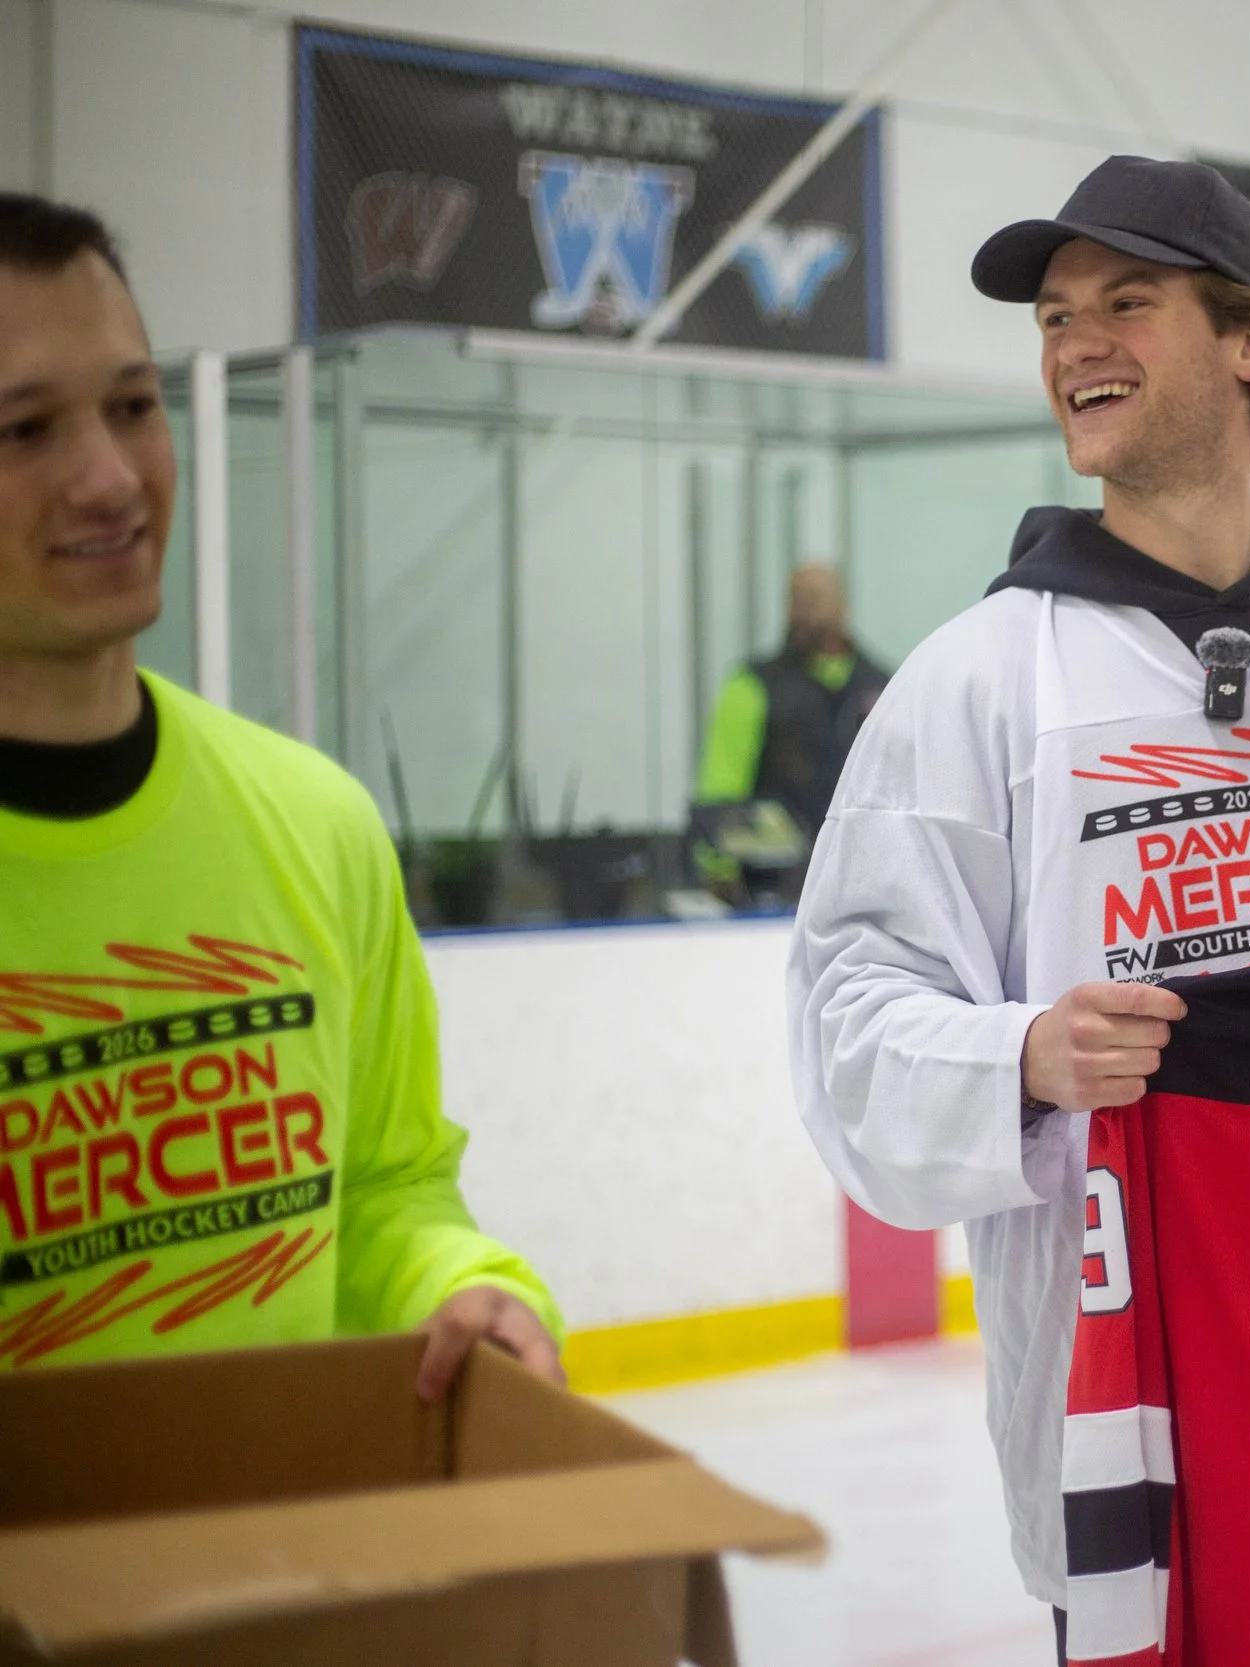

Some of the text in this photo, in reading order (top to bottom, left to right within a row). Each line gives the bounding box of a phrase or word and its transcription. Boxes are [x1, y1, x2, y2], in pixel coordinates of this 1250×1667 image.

[97, 1026, 157, 1063] 2026
[0, 1041, 279, 1152] DAWSON
[26, 1182, 322, 1278] YOUTH HOCKEY CAMP
